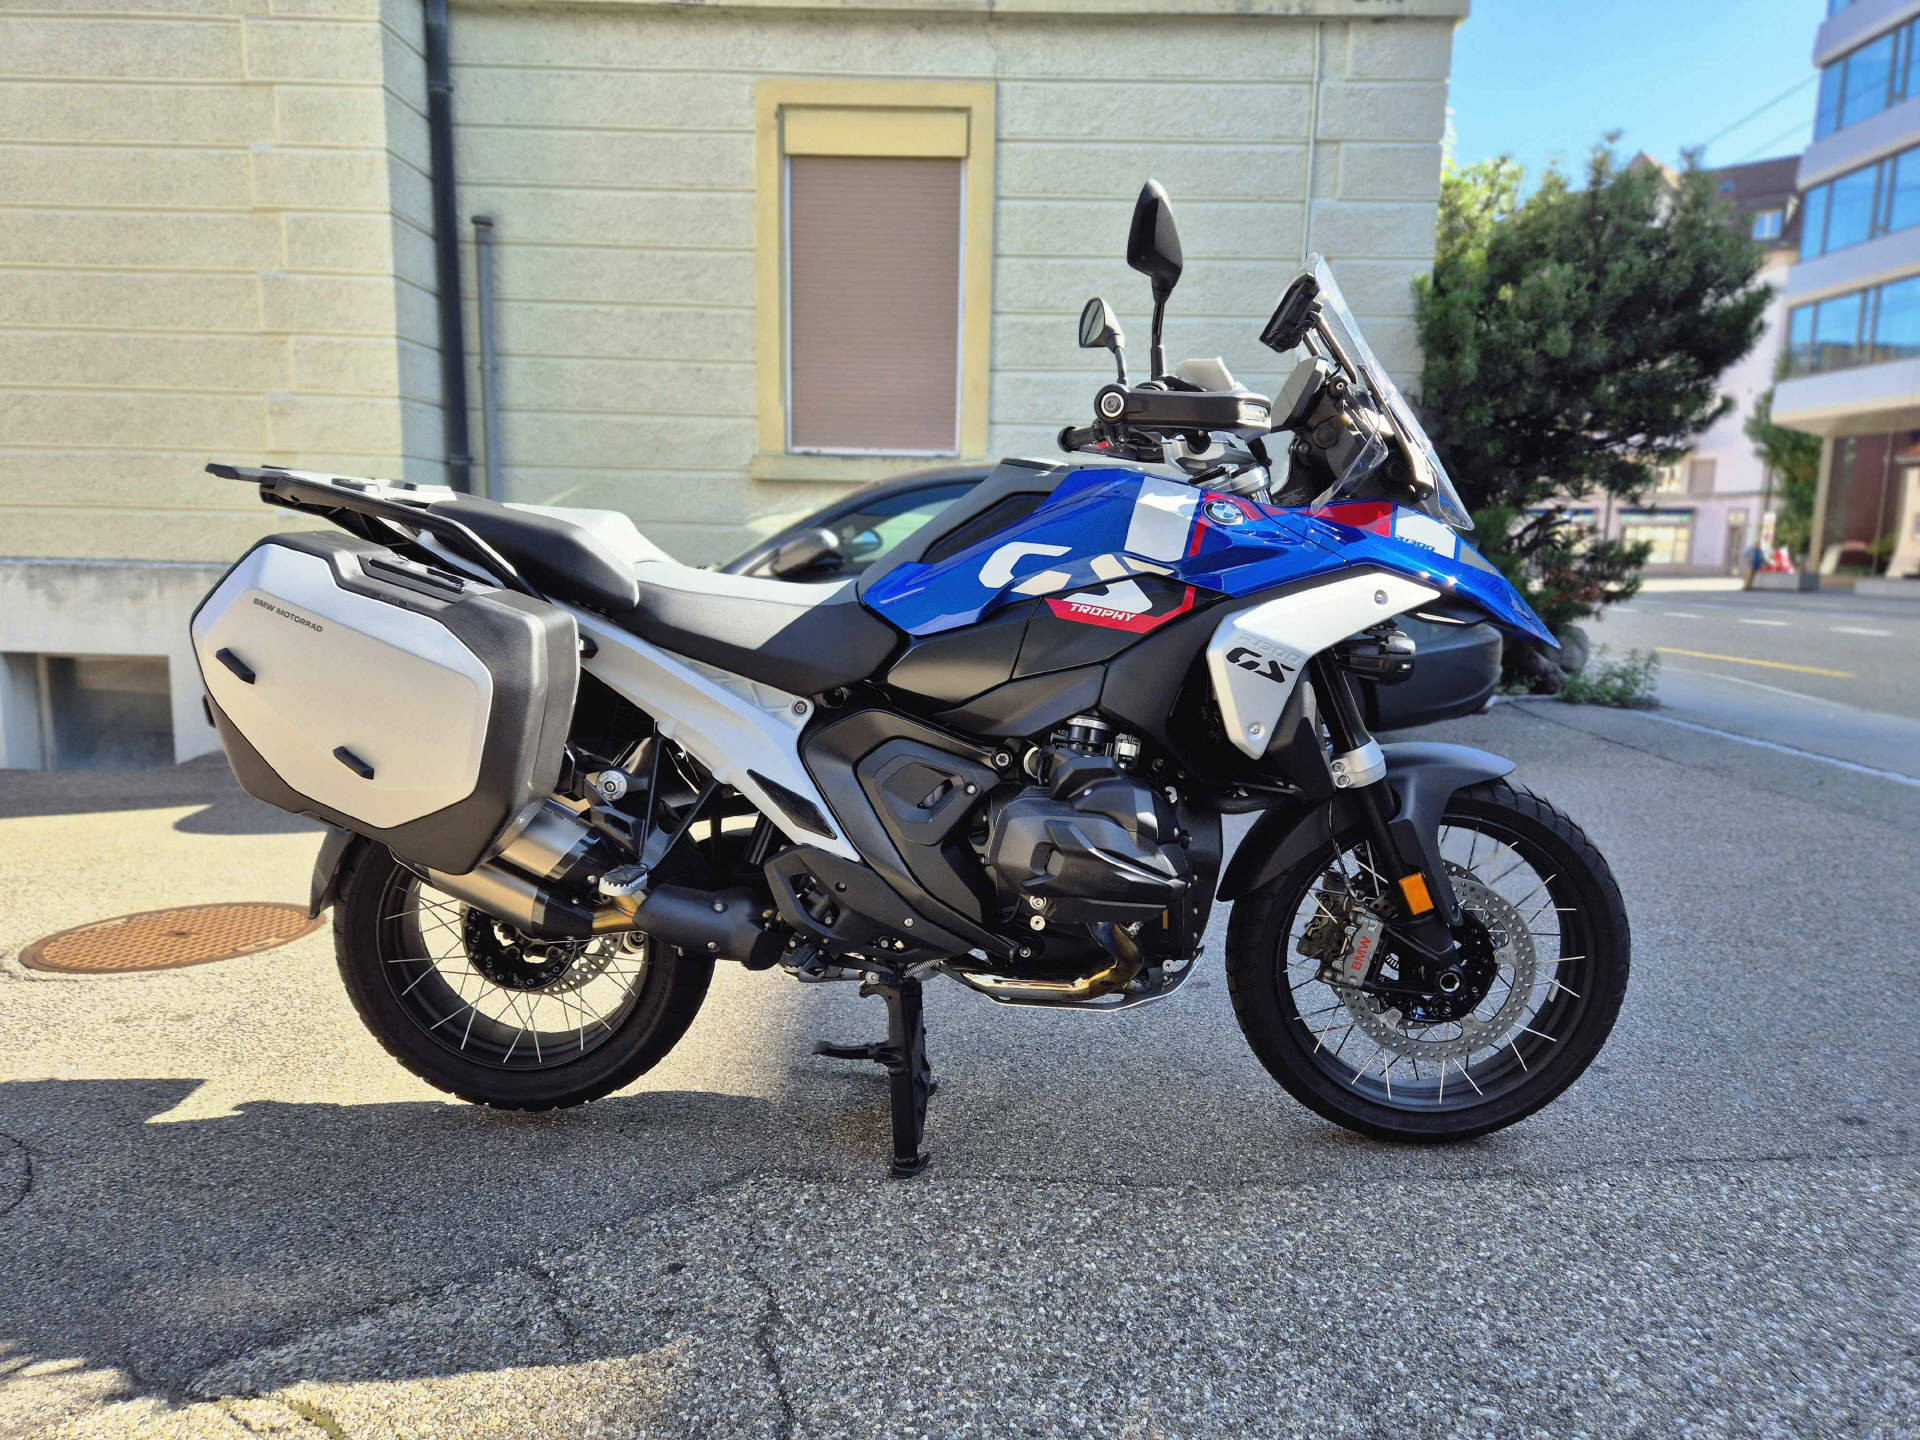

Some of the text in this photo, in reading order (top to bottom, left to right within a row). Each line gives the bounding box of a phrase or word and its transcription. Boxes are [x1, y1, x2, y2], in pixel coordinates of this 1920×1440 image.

[978, 541, 1175, 614] GS
[253, 597, 323, 633] BMW MOTORRAD
[1070, 602, 1136, 623] TROPHY
[1225, 646, 1297, 684] GS
[1351, 936, 1371, 971] BMW
